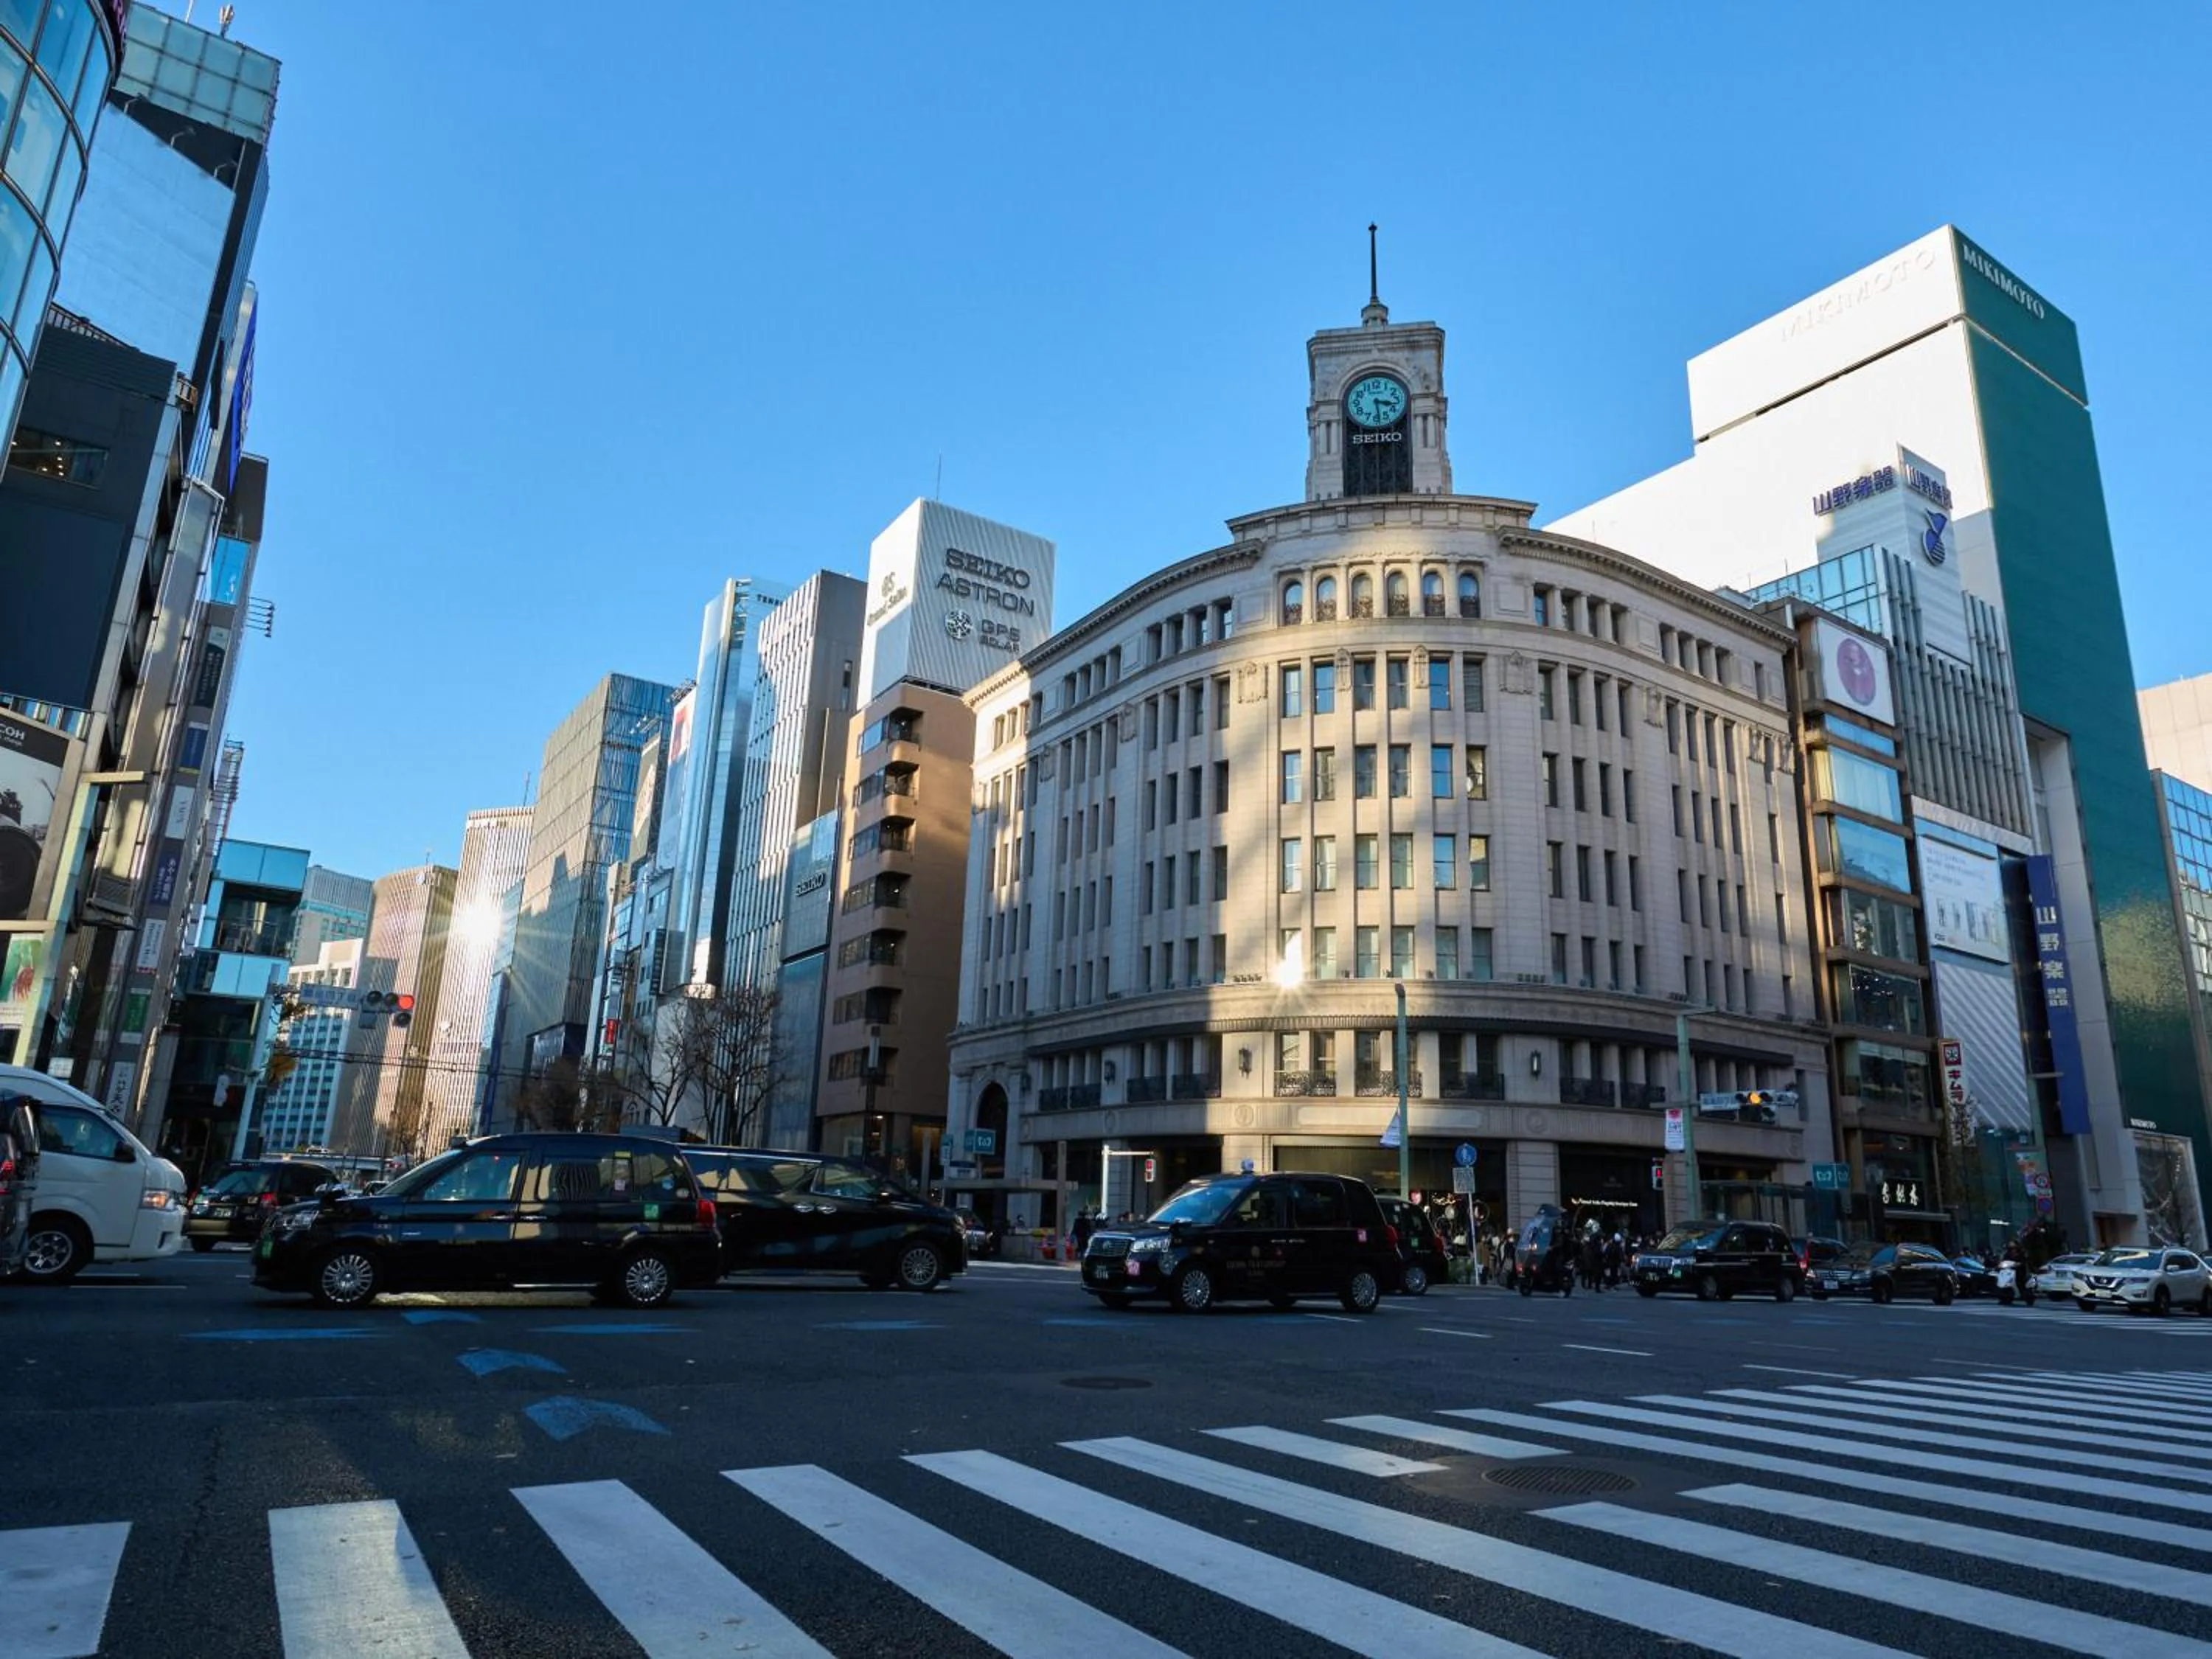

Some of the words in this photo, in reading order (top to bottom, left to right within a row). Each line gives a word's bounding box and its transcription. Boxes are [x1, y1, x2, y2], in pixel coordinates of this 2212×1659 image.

[1963, 243, 2045, 320] MIKIMOTO
[1352, 432, 1402, 445] SEIKO
[1812, 465, 1897, 517] 山野楽器
[945, 548, 1031, 589] SEIKO
[936, 572, 1034, 617] ASTRON
[980, 619, 1021, 642] GPS
[796, 870, 827, 897] SEIKO
[2036, 906, 2069, 1007] 山野楽器
